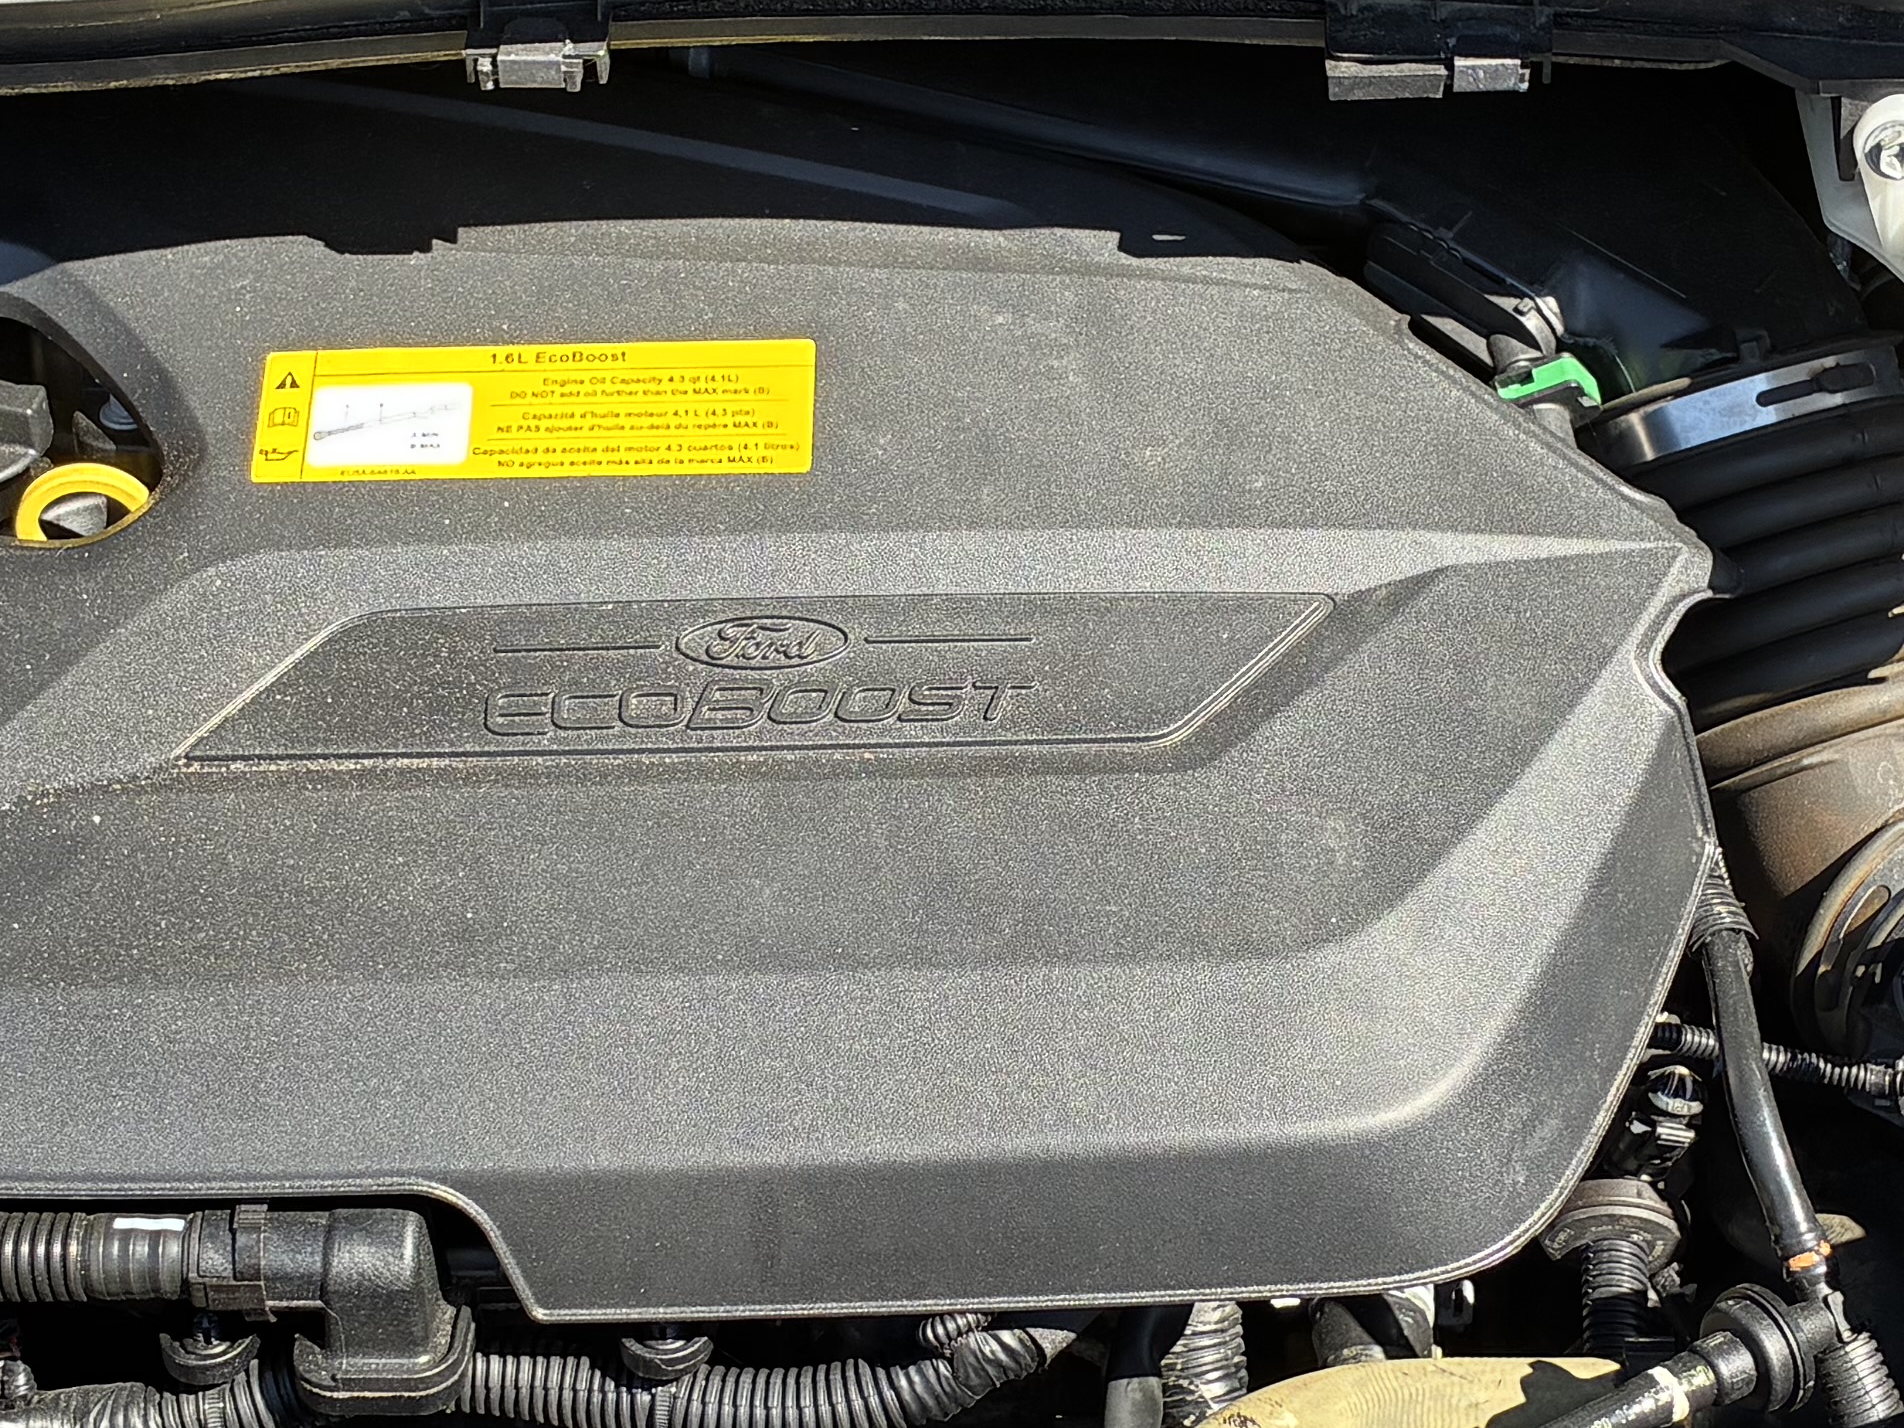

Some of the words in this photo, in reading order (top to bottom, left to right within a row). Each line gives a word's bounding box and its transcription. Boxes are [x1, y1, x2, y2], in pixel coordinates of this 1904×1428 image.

[489, 352, 529, 365] 1.6L
[534, 351, 627, 364] EcoBoost
[542, 377, 586, 388] Engine
[588, 376, 607, 386] Oil
[609, 375, 663, 386] Capacity
[688, 375, 701, 385] qt
[509, 390, 528, 400] DO
[531, 390, 556, 400] NOT
[559, 390, 582, 399] add
[583, 389, 598, 398] oil
[600, 388, 640, 398] further
[642, 388, 668, 396] than
[670, 388, 689, 396] the
[692, 387, 720, 396] MAX
[721, 387, 750, 395] mark
[521, 411, 576, 422] Capacité
[579, 410, 621, 420] d'huile
[624, 410, 669, 419] moteur
[496, 425, 513, 434] NE
[516, 424, 541, 433] PAS
[544, 424, 584, 434] ajouter
[587, 423, 626, 433] d'huile
[673, 422, 689, 431] du
[692, 422, 729, 431] repère
[732, 420, 758, 429] MAX
[471, 445, 539, 457] Capacidad
[542, 446, 557, 454] de
[560, 445, 598, 454] aceite
[601, 444, 621, 453] del
[623, 444, 661, 453] motor
[686, 443, 734, 452] cuartos
[497, 460, 515, 468] NO
[518, 460, 565, 470] agregue
[568, 459, 603, 468] aceite
[656, 457, 671, 465] de
[674, 457, 685, 465] la
[687, 457, 723, 465] marca
[726, 455, 754, 465] MAX
[704, 620, 820, 662] Ford
